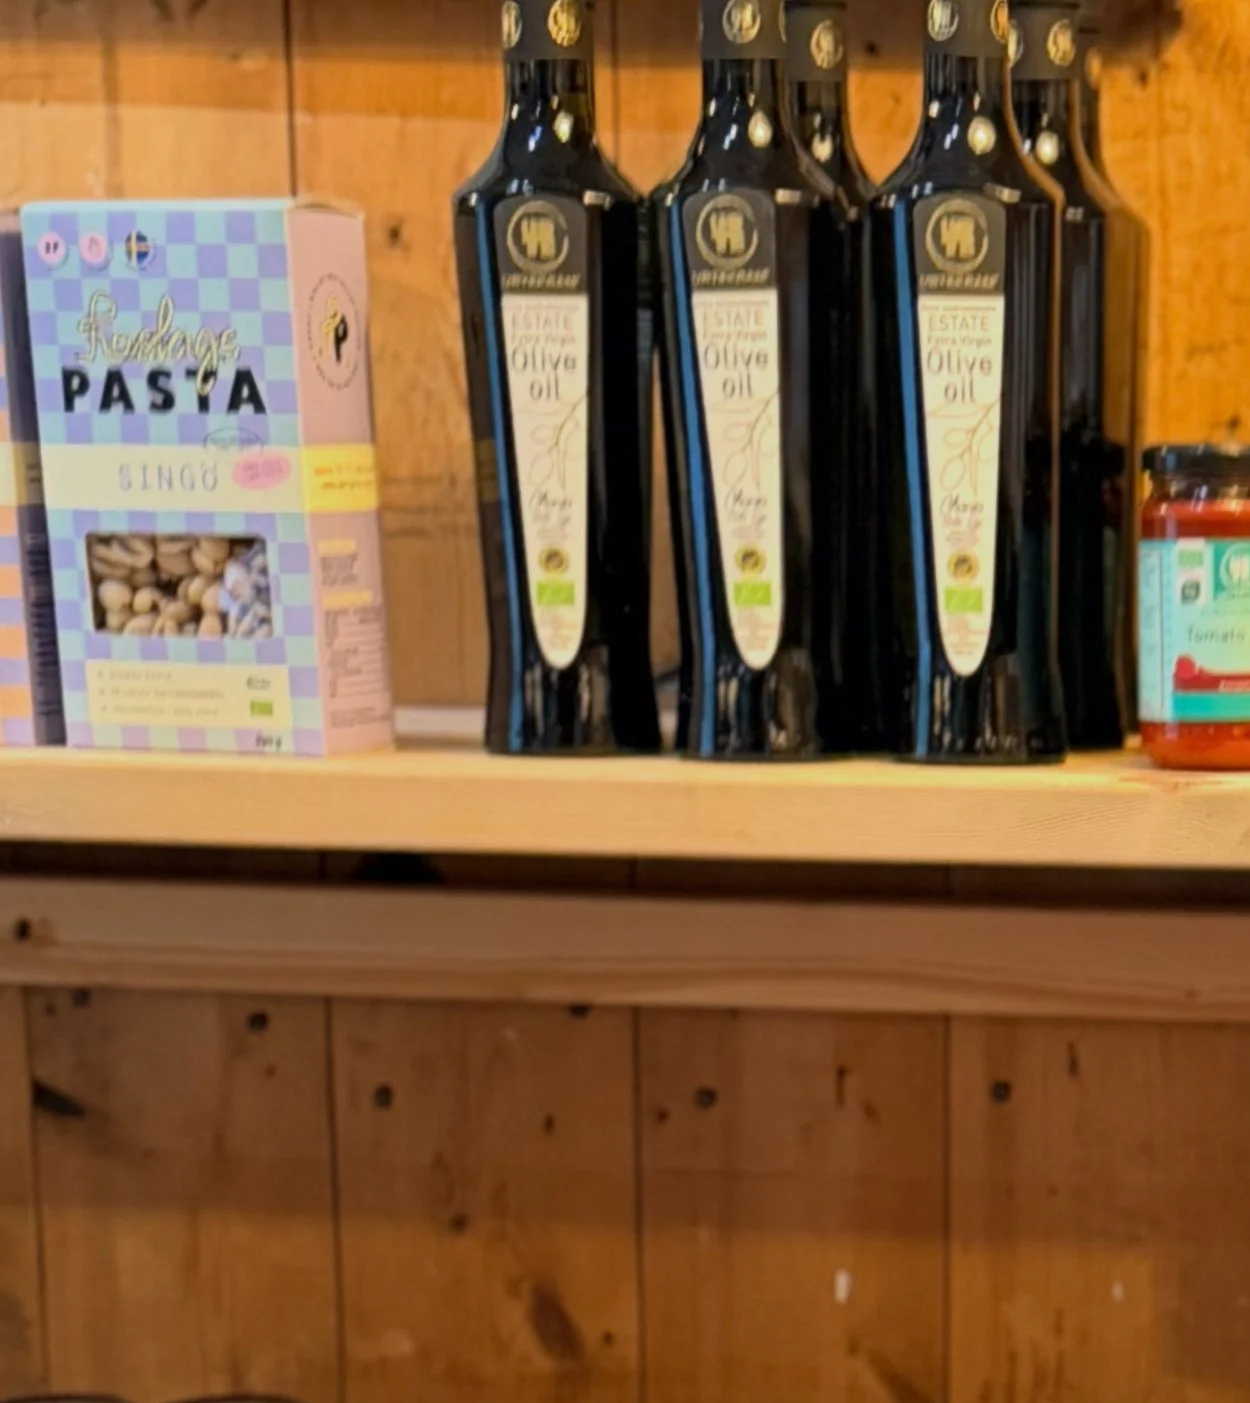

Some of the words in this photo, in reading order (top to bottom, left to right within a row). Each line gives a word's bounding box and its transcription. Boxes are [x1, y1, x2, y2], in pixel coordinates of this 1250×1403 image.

[928, 315, 990, 333] ESTATE
[511, 345, 577, 373] Olive
[704, 342, 769, 370] Olive
[926, 347, 993, 376] Olive
[61, 367, 268, 414] PASTA
[529, 371, 560, 402] oil
[722, 369, 753, 401] oil
[944, 373, 976, 403] oil
